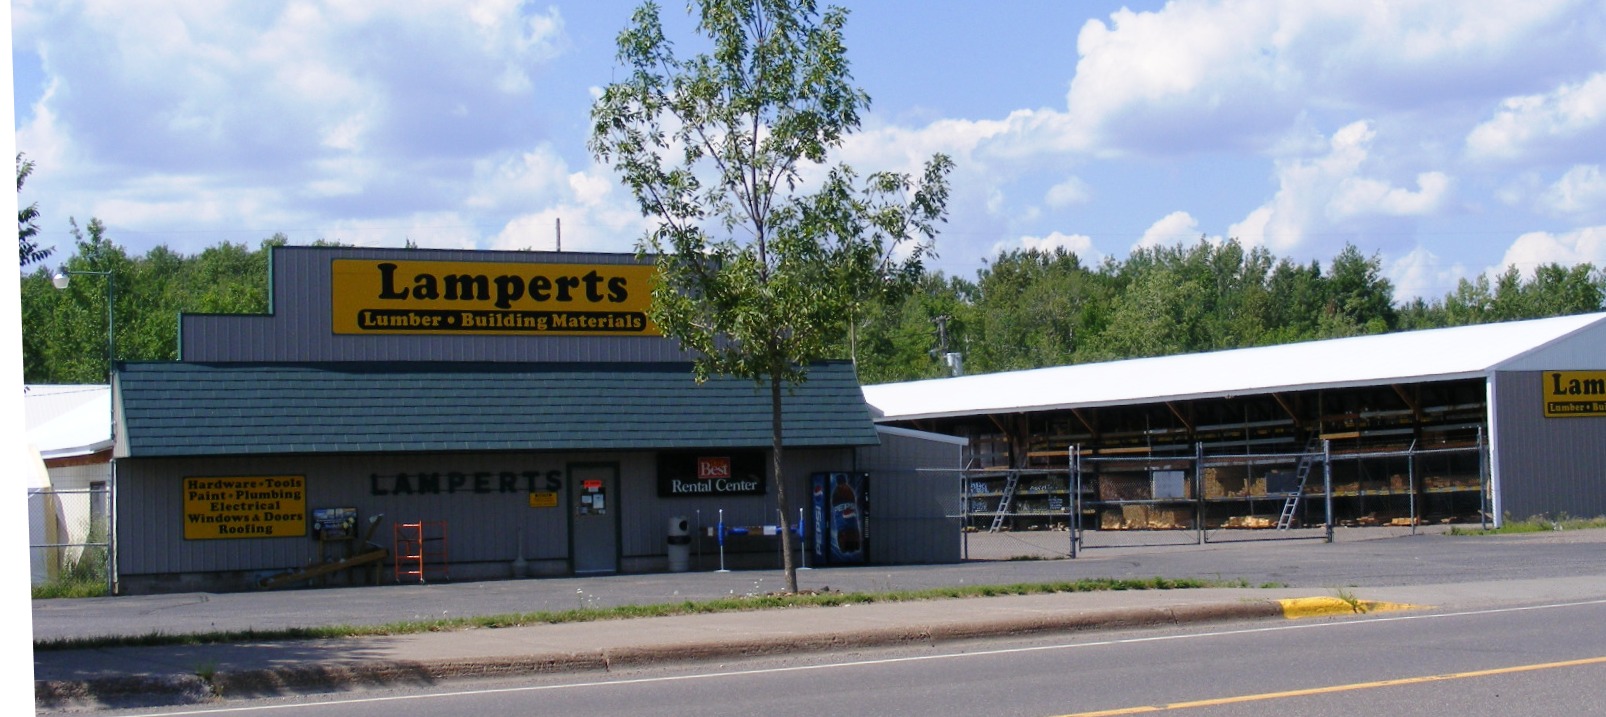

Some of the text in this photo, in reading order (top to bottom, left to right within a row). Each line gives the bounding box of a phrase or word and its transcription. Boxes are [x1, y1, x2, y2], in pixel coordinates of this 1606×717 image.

[377, 262, 629, 309] Lamperts
[364, 311, 642, 330] Lumber Building Materials
[1551, 373, 1606, 395] Lam
[1549, 402, 1585, 412] Lumber
[700, 461, 728, 476] Best
[188, 478, 301, 489] Hardware Tools
[370, 470, 563, 496] LAMPERTS
[672, 478, 757, 493] Rental Center
[188, 489, 301, 501] Paint Plumbing
[210, 501, 280, 511] Electrical
[188, 512, 303, 523] Windows & Doors
[218, 523, 273, 535] Roofing
